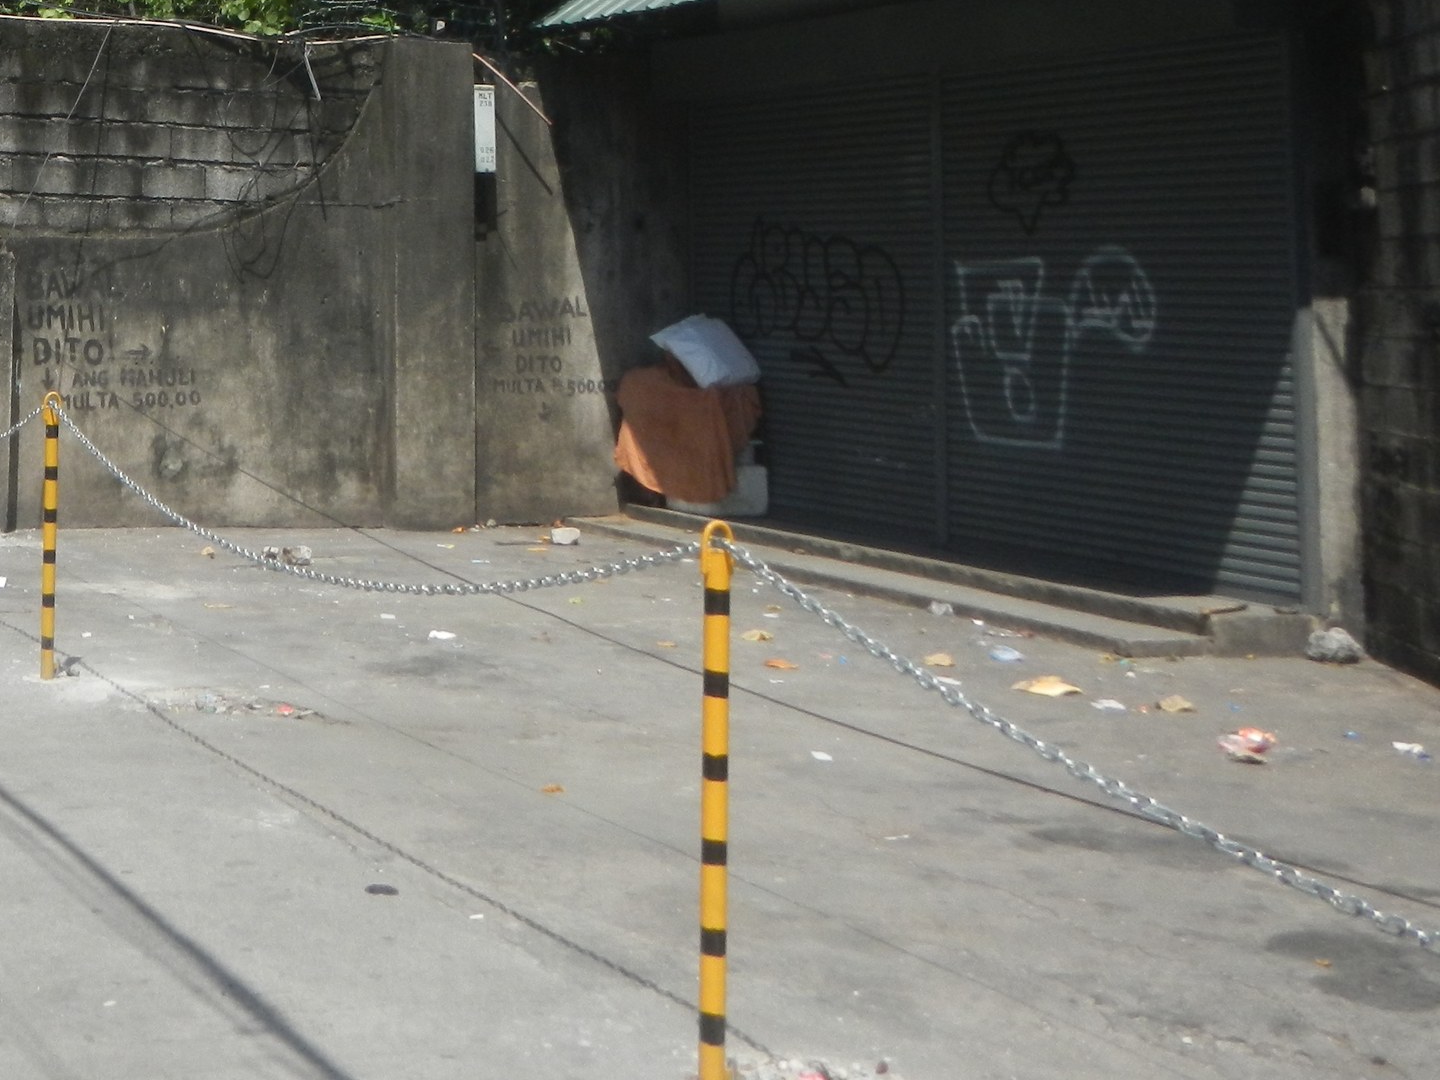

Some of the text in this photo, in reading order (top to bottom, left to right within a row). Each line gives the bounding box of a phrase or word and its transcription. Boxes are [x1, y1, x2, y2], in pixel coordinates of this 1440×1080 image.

[27, 302, 105, 332] UMIHI
[32, 337, 104, 366] DITO
[514, 354, 563, 375] DITO
[71, 369, 109, 389] ANG
